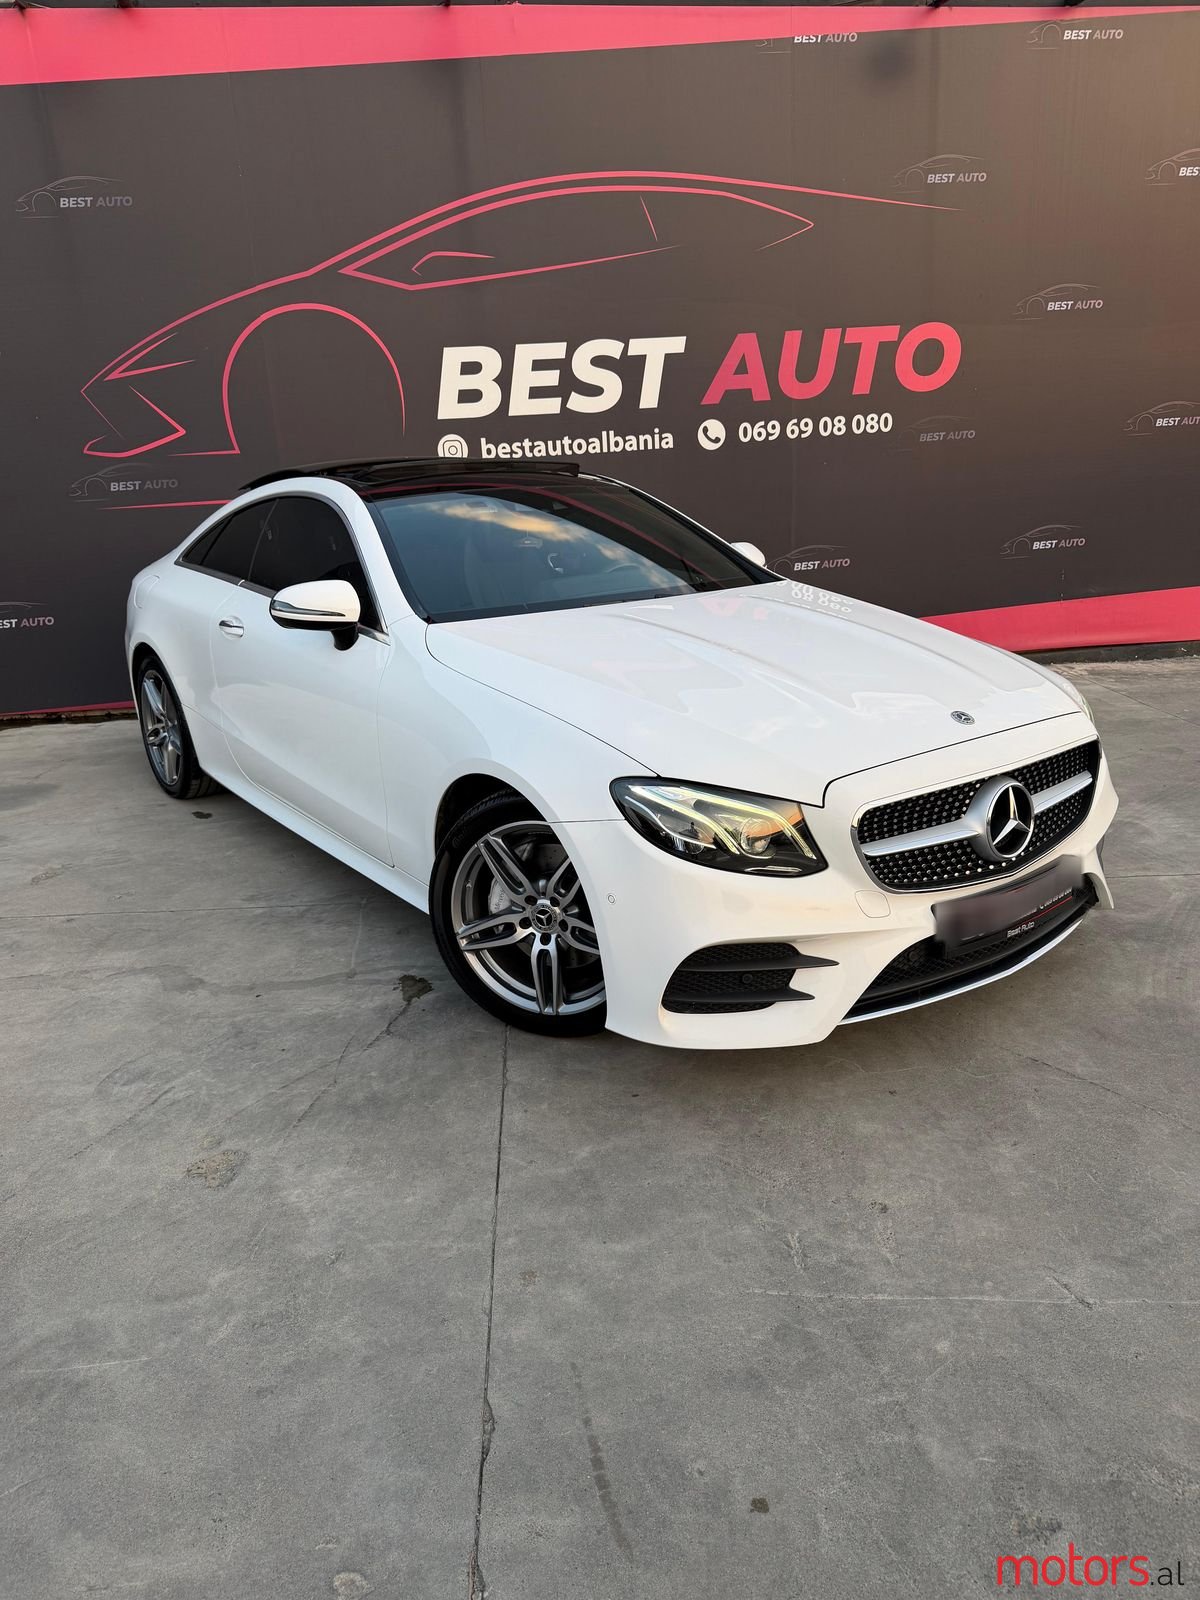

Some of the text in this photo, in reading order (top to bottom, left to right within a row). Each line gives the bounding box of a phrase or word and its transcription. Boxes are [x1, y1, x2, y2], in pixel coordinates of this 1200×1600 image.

[825, 32, 858, 43] AUTO
[1063, 29, 1124, 40] BEST AUTO
[1179, 166, 1200, 177] BES
[927, 172, 987, 184] BEST AUTO
[60, 196, 133, 208] BEST AUTO
[1047, 299, 1103, 311] BEST AUTO
[437, 321, 962, 420] BEST AUTO
[738, 412, 893, 443] 069 69 08 080
[1155, 417, 1180, 427] BEST
[919, 430, 976, 442] BEST AUTO
[480, 428, 674, 459] bestautoalbania
[110, 479, 179, 492] BEST AUTO
[1032, 538, 1086, 550] BEST AUTO
[793, 558, 851, 571] BEST AUTO
[20, 616, 55, 628] AUTO
